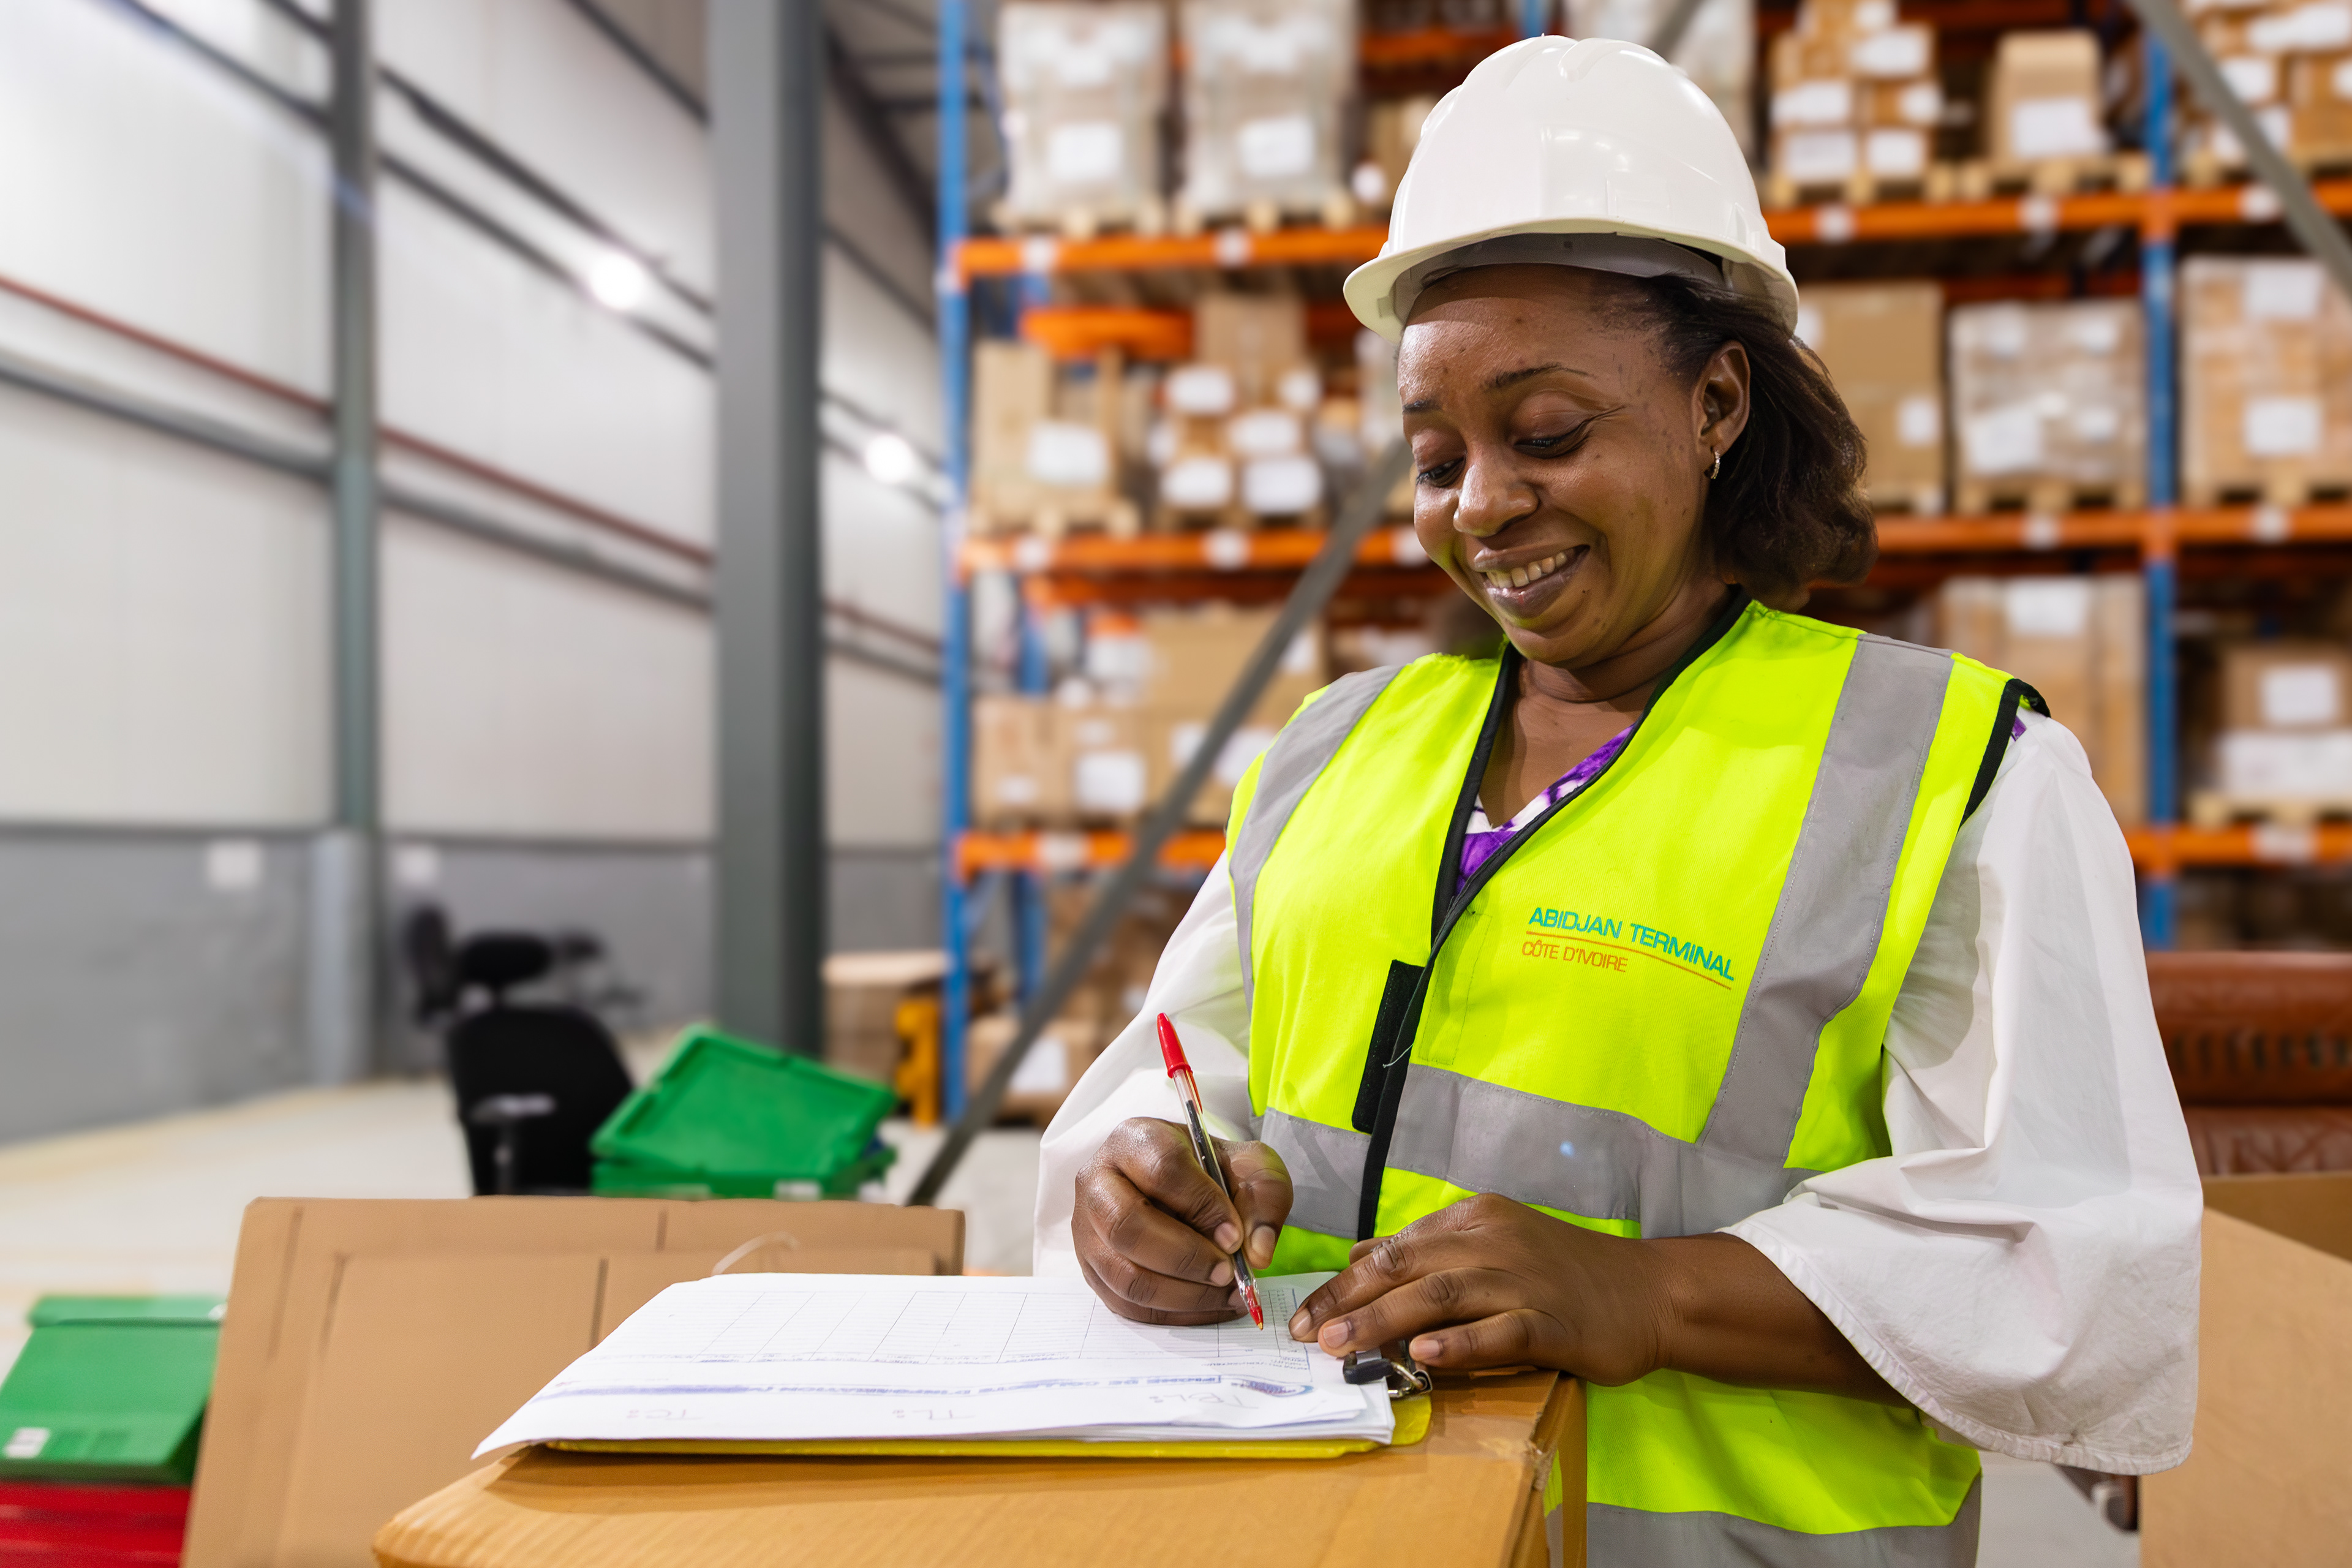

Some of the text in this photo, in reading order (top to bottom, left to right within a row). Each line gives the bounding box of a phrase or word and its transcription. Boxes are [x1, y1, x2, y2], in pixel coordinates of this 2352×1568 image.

[1521, 939, 1629, 973] CÔTE D'IVOIRE
[1528, 907, 1735, 982] ABIDJAN TERMINAL
